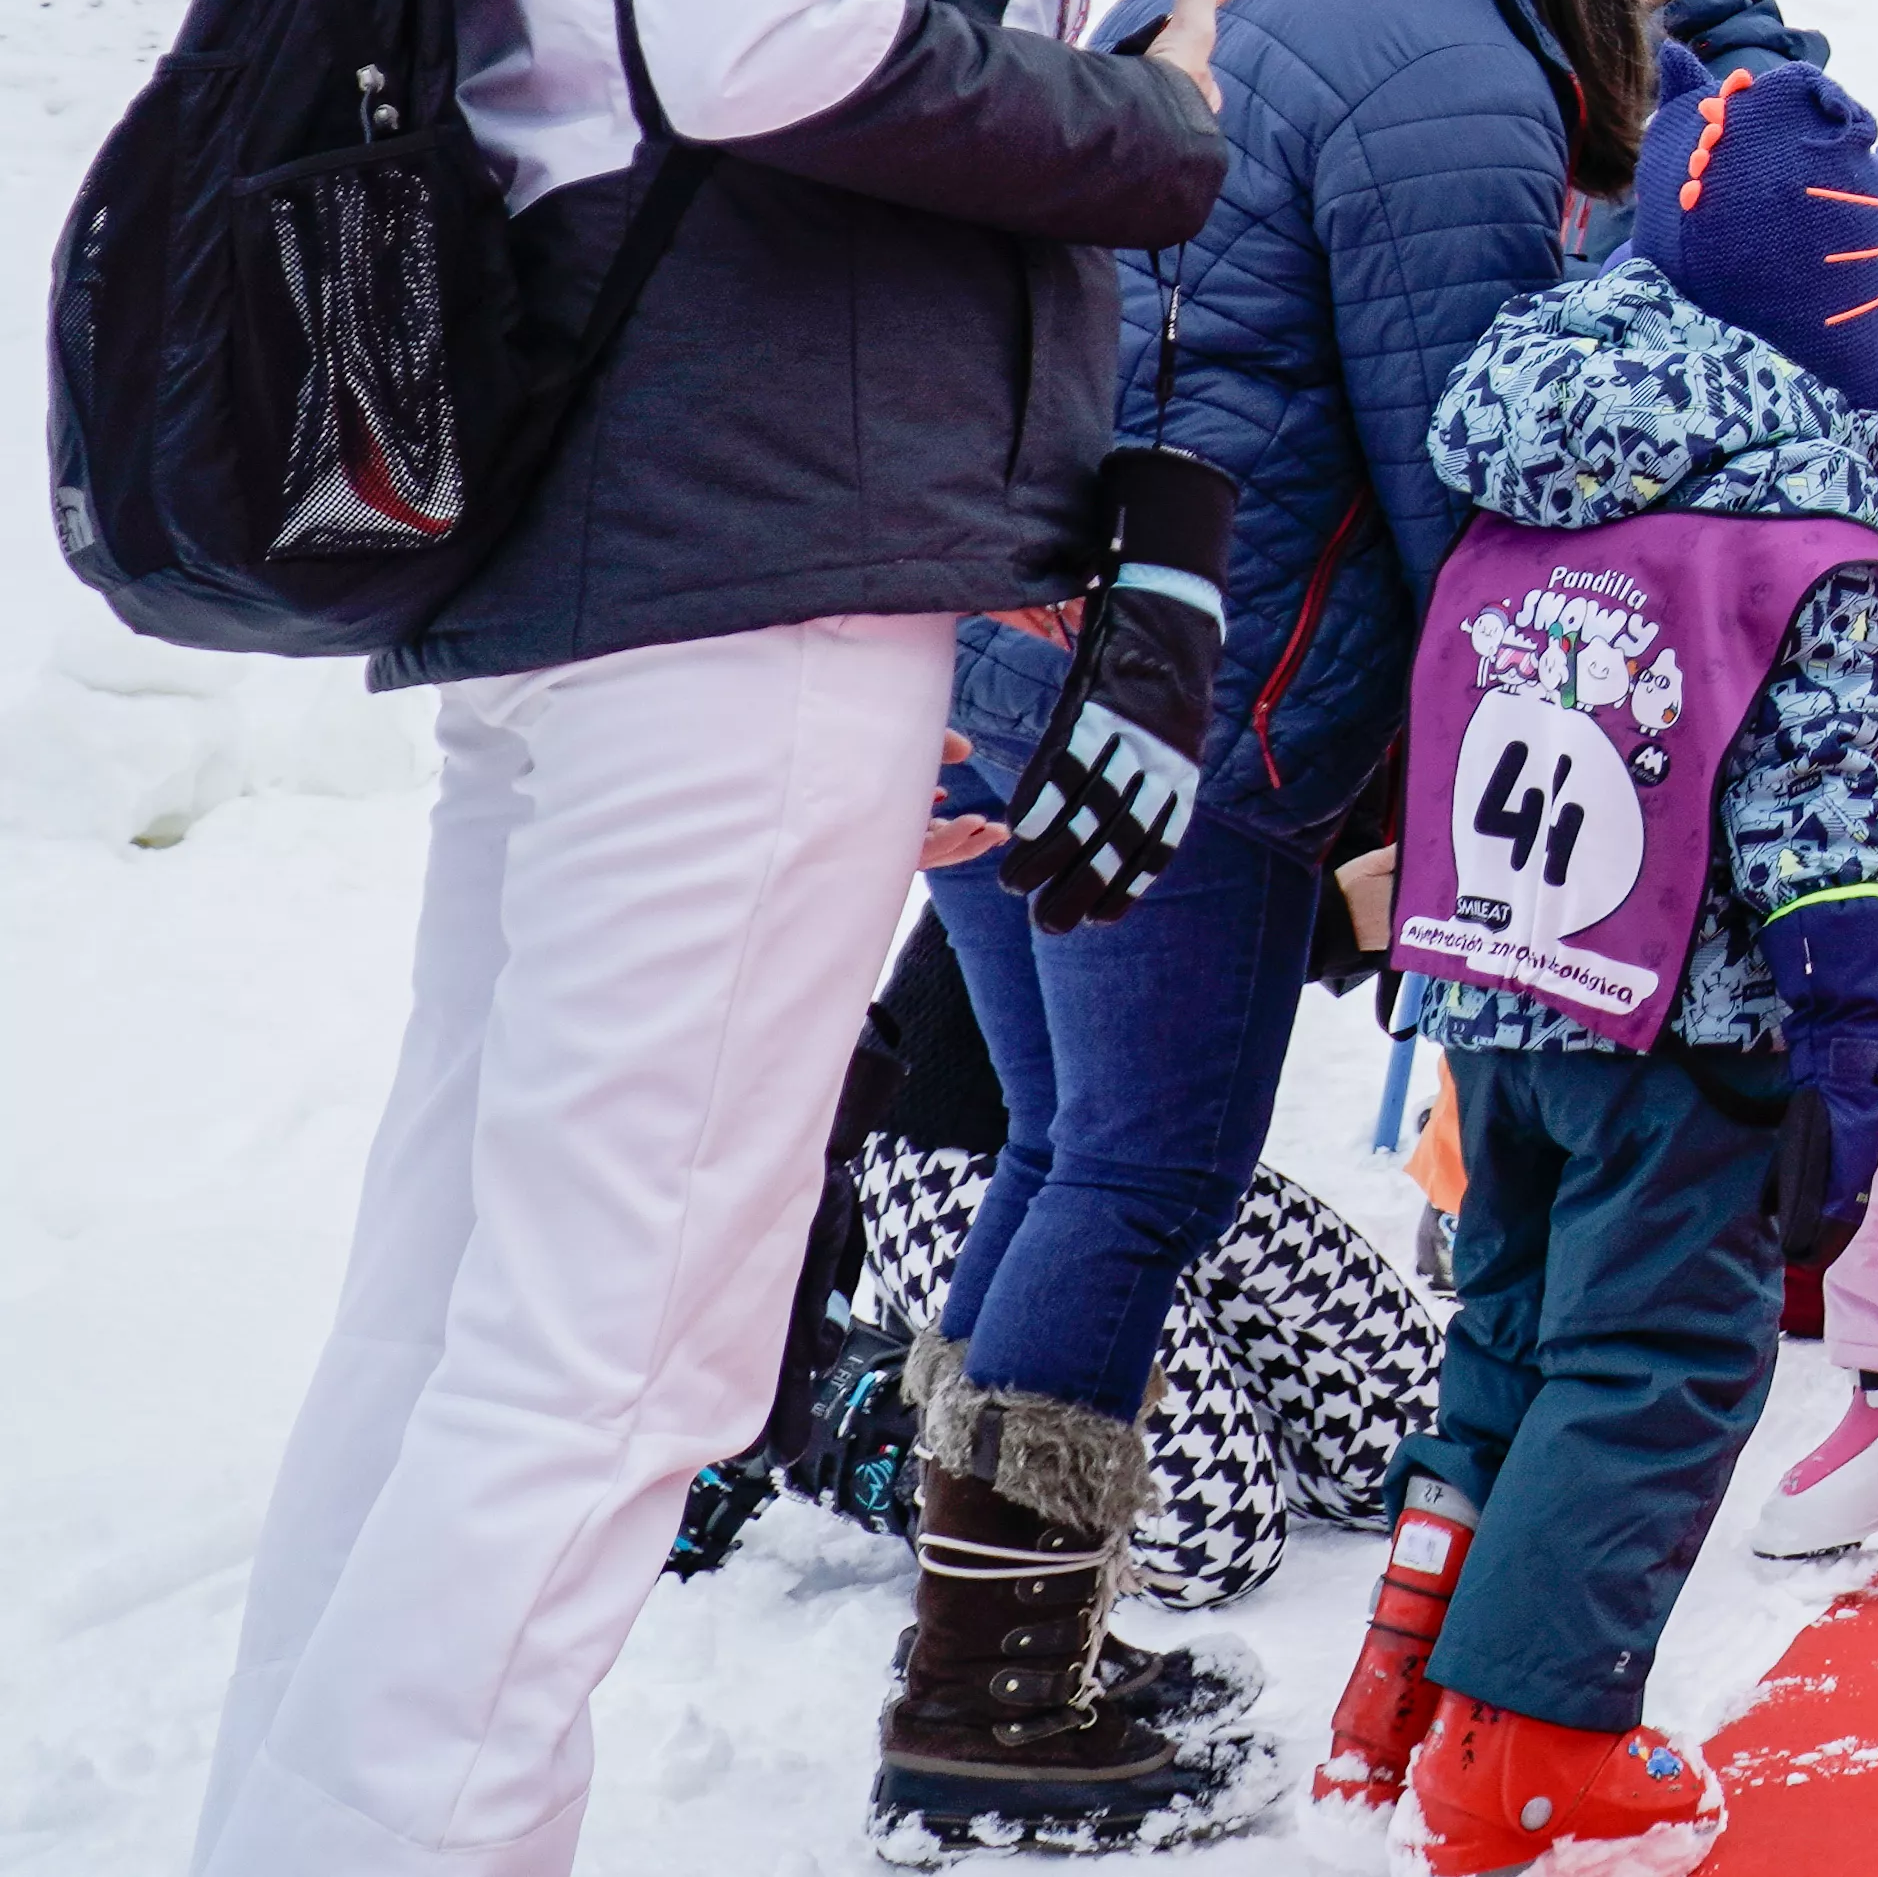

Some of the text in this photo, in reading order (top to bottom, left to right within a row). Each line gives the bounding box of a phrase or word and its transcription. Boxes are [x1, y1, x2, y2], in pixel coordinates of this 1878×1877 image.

[1547, 565, 1649, 611] Pandilla
[1515, 588, 1661, 658] SNOWY
[1456, 897, 1512, 923] SMILEAT
